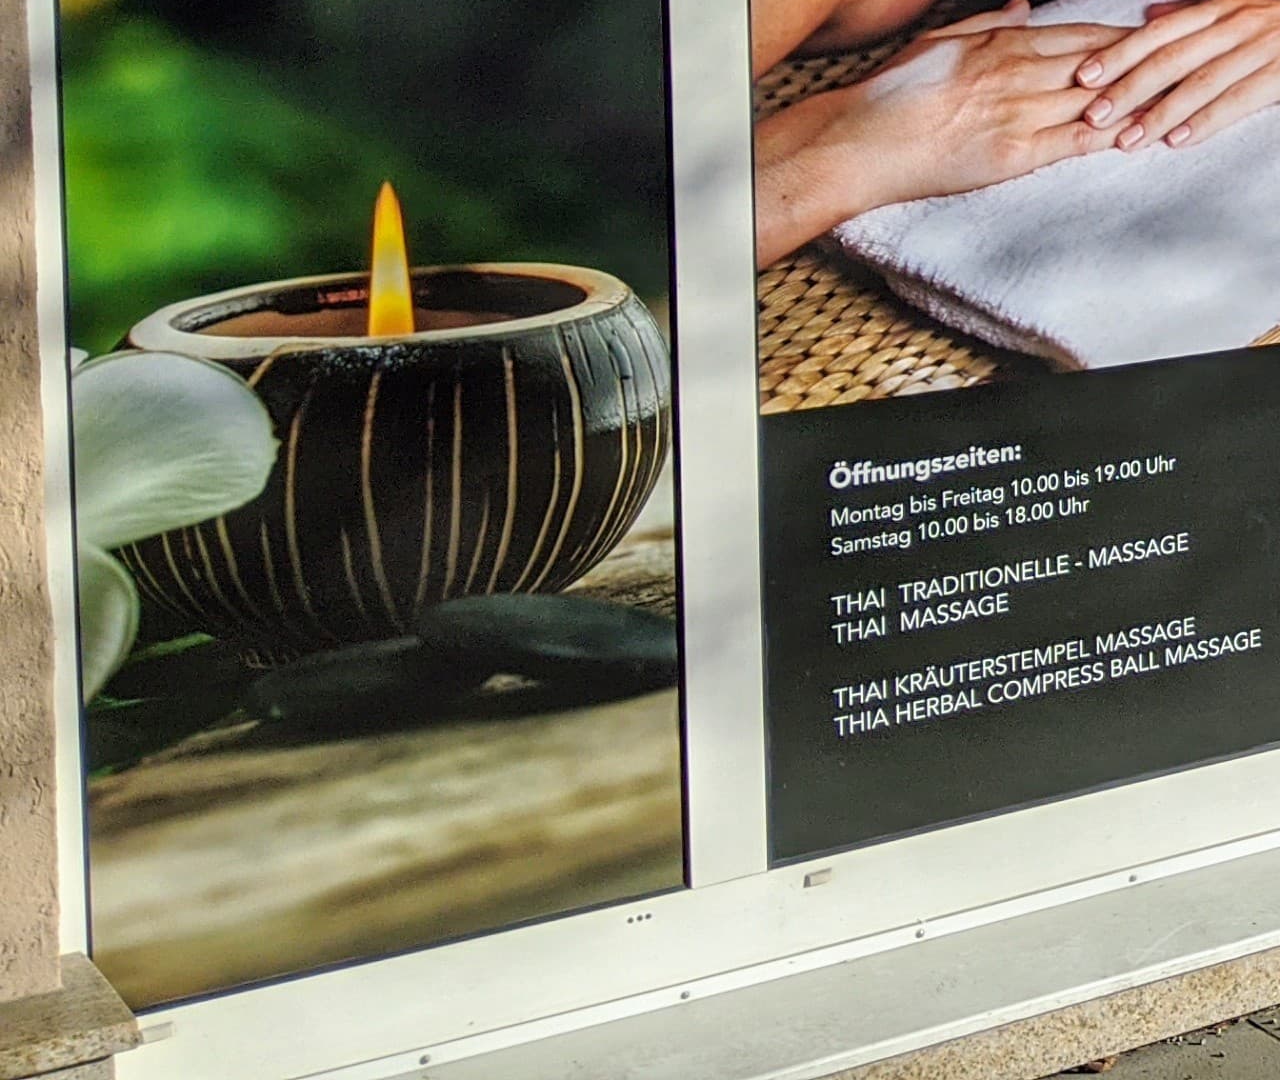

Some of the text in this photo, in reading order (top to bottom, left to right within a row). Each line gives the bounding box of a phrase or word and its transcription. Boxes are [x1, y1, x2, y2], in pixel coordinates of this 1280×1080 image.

[829, 444, 1022, 489] Öffnungszeiten:
[830, 454, 1177, 527] Montag bis Freitag 10.00 bis 19.00 Uhr
[831, 496, 1091, 556] Samstag 10.00 bis 18.00 Uhr
[830, 587, 886, 616] THAI
[898, 553, 1070, 604] TRADITIONELLE
[1088, 532, 1190, 569] MASSAGE
[831, 592, 1009, 644] THAI MASSAGE
[832, 616, 1196, 709] THAI KRÄUTERSTEMPEL MASSAGE
[833, 628, 1262, 737] THIA HERBAL COMPRESS BALL MASSAGE
